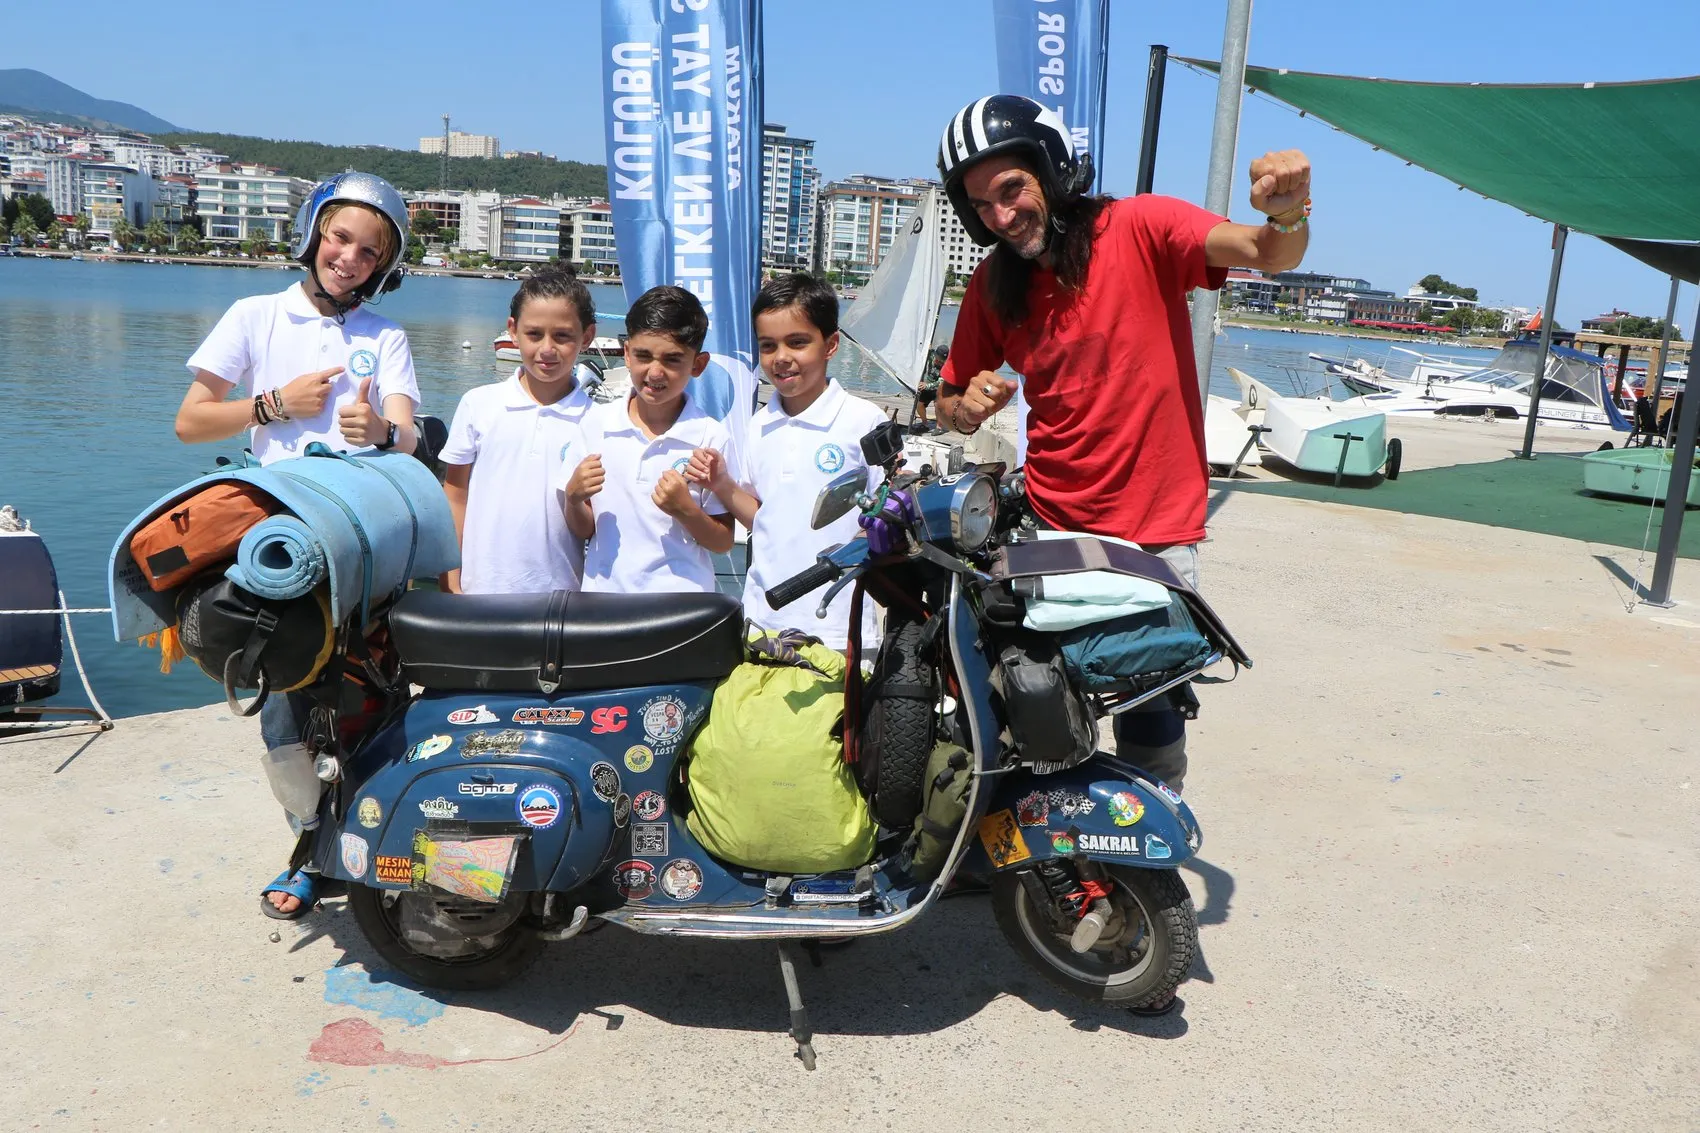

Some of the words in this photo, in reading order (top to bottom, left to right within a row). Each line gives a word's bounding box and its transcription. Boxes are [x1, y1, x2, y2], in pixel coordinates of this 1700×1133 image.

[1537, 408, 1577, 418] AYLINER
[591, 706, 629, 735] SC
[654, 745, 677, 756] LOST
[1078, 834, 1139, 852] SAKRAL
[376, 856, 410, 868] MESIN
[376, 868, 412, 878] KANAN
